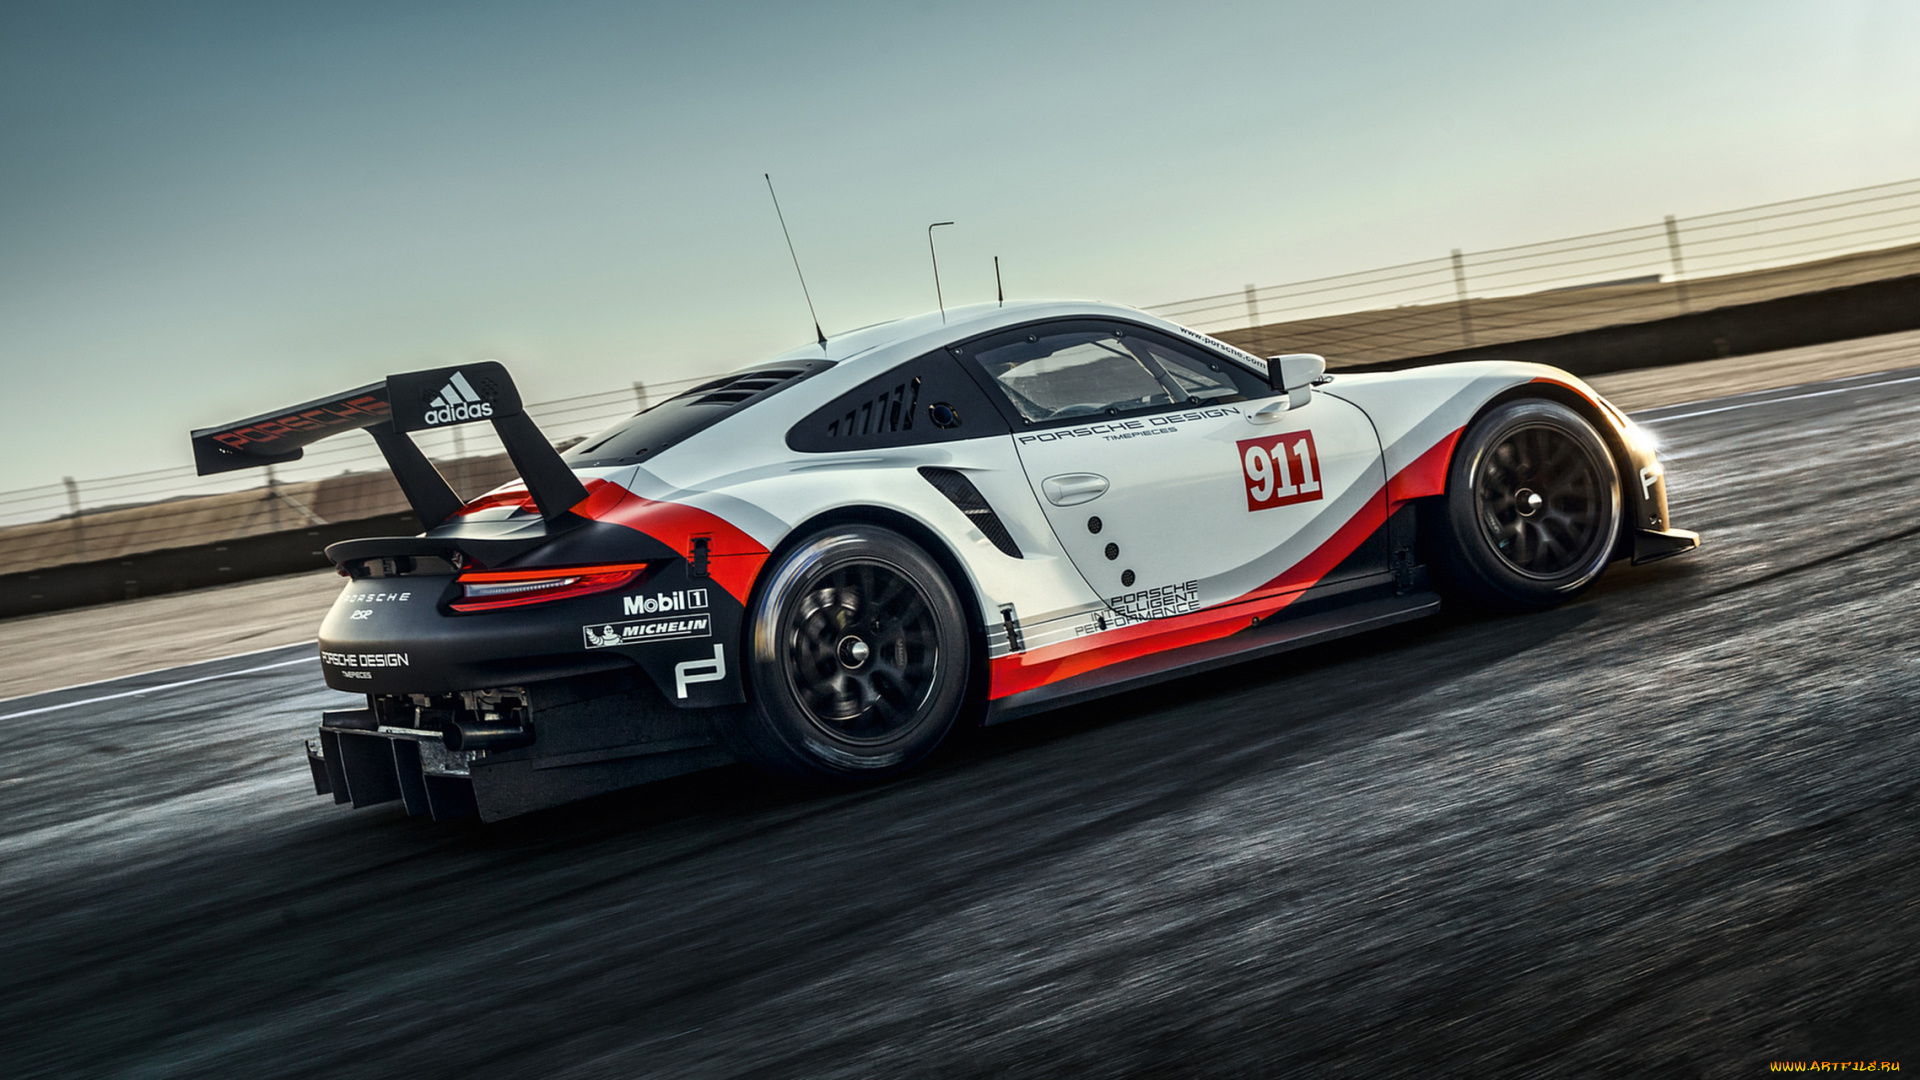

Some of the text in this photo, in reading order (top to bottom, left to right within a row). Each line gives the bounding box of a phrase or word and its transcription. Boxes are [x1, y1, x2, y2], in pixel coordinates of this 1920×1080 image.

[1180, 327, 1266, 369] www.porsche.com
[212, 396, 392, 450] PORSCHE
[424, 402, 493, 425] adidas
[1018, 406, 1241, 445] PORSCHE DESIGN
[1102, 426, 1178, 442] TIMEPIECES
[1245, 438, 1320, 502] 911
[344, 592, 411, 603] PORSCHE
[623, 591, 685, 615] Mobil
[1091, 590, 1198, 621] INTELLIGENT
[1111, 580, 1198, 606] PORSCHE
[622, 619, 707, 636] MICHELIN
[321, 651, 409, 667] PORSCHE DESIGN
